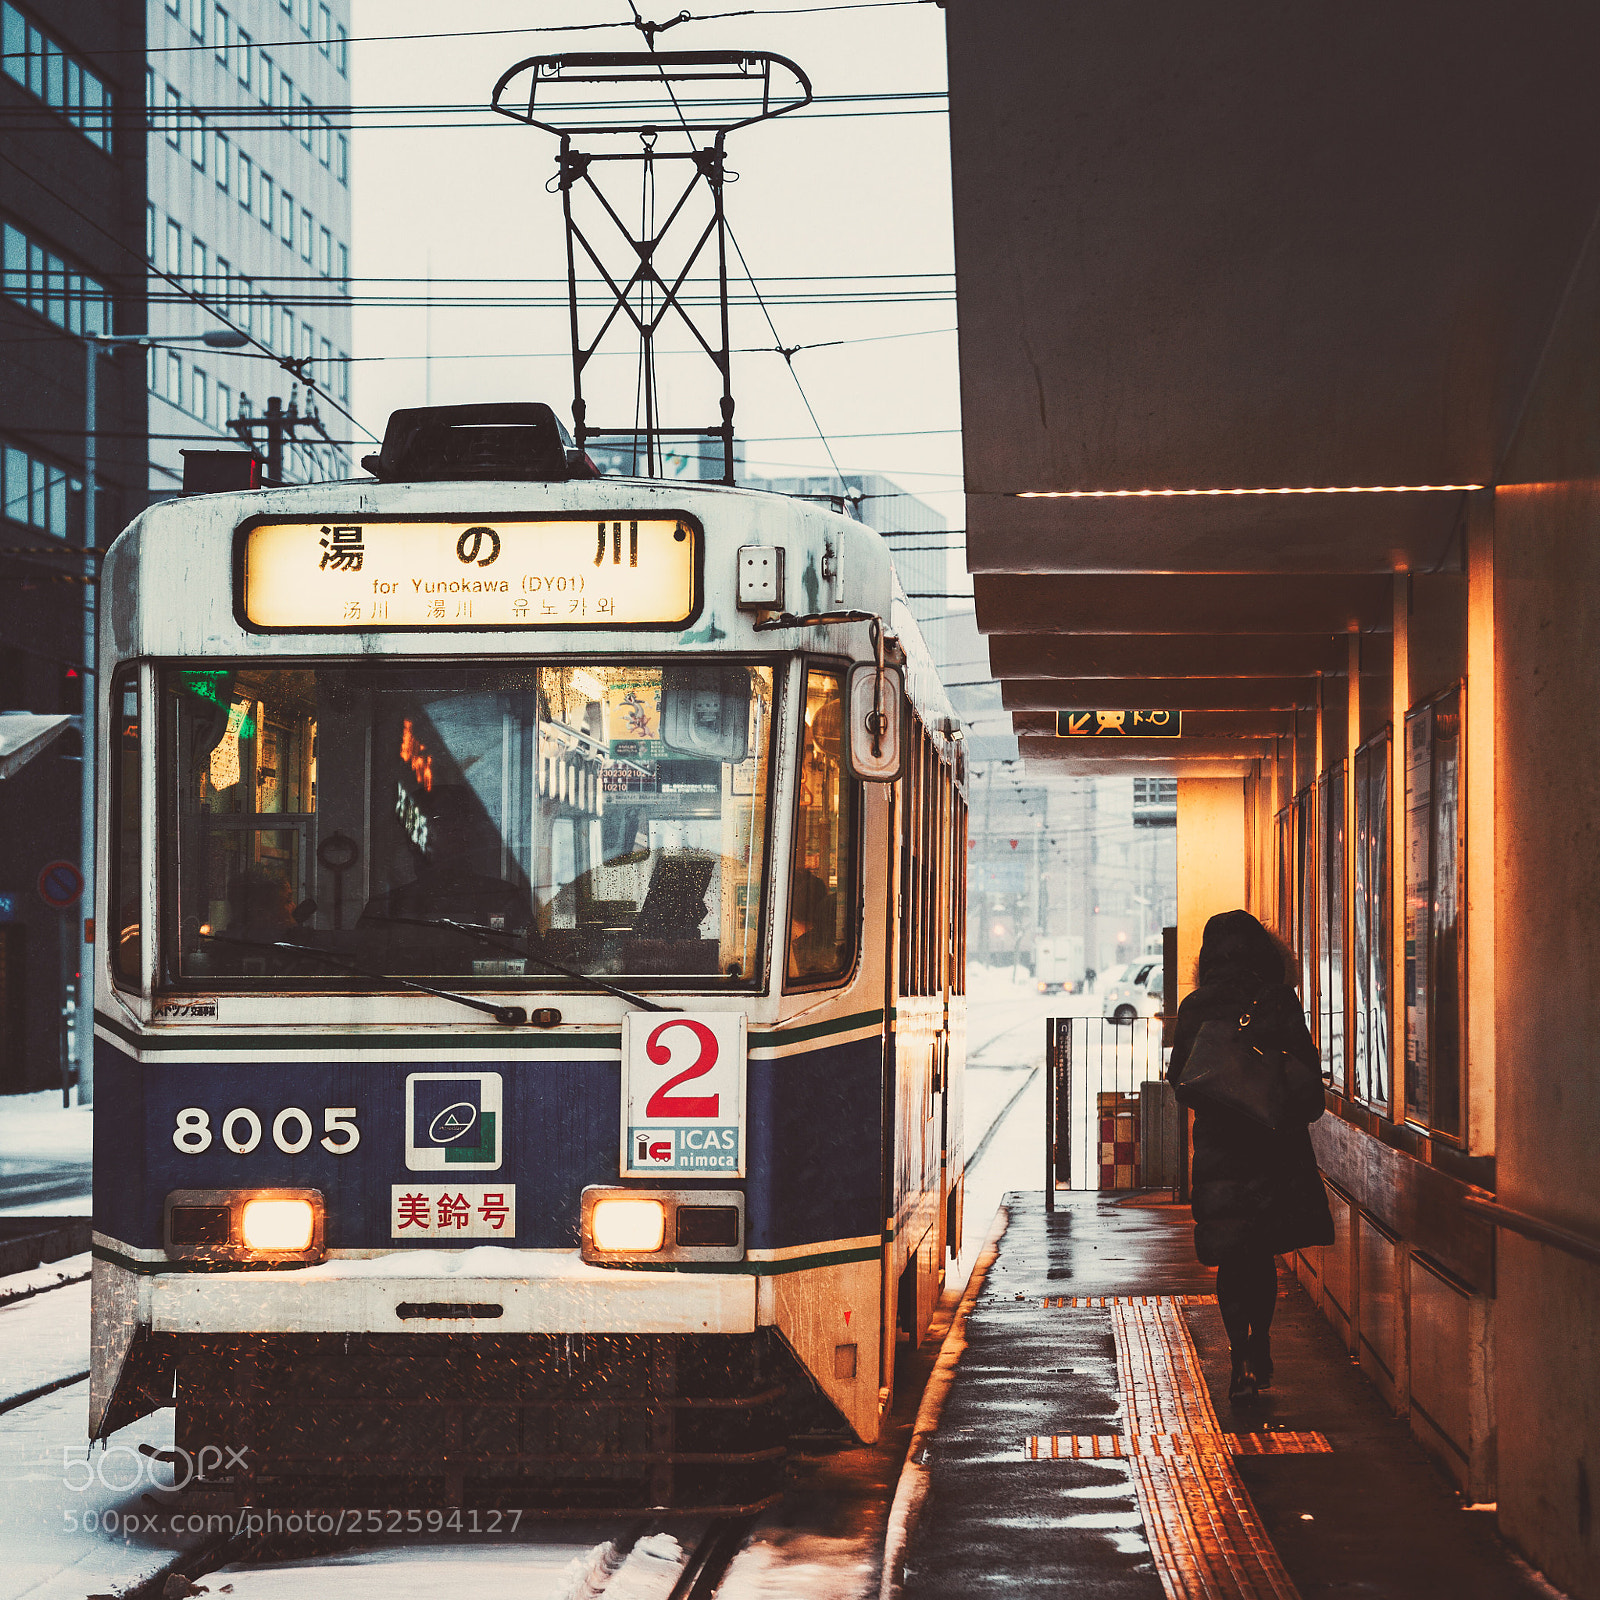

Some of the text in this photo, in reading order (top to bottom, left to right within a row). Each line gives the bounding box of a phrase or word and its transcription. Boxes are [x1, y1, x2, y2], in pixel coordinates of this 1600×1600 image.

[318, 521, 639, 572] 湯の川
[373, 576, 586, 594] for Yunokawa (DY01)
[426, 599, 473, 619] 湯川
[511, 597, 616, 618] 유노카와
[646, 1019, 719, 1118] 2
[172, 1107, 362, 1156] 8005
[680, 1129, 735, 1150] ICAS
[680, 1152, 735, 1167] nimoca
[397, 1193, 511, 1231] 美鈴号
